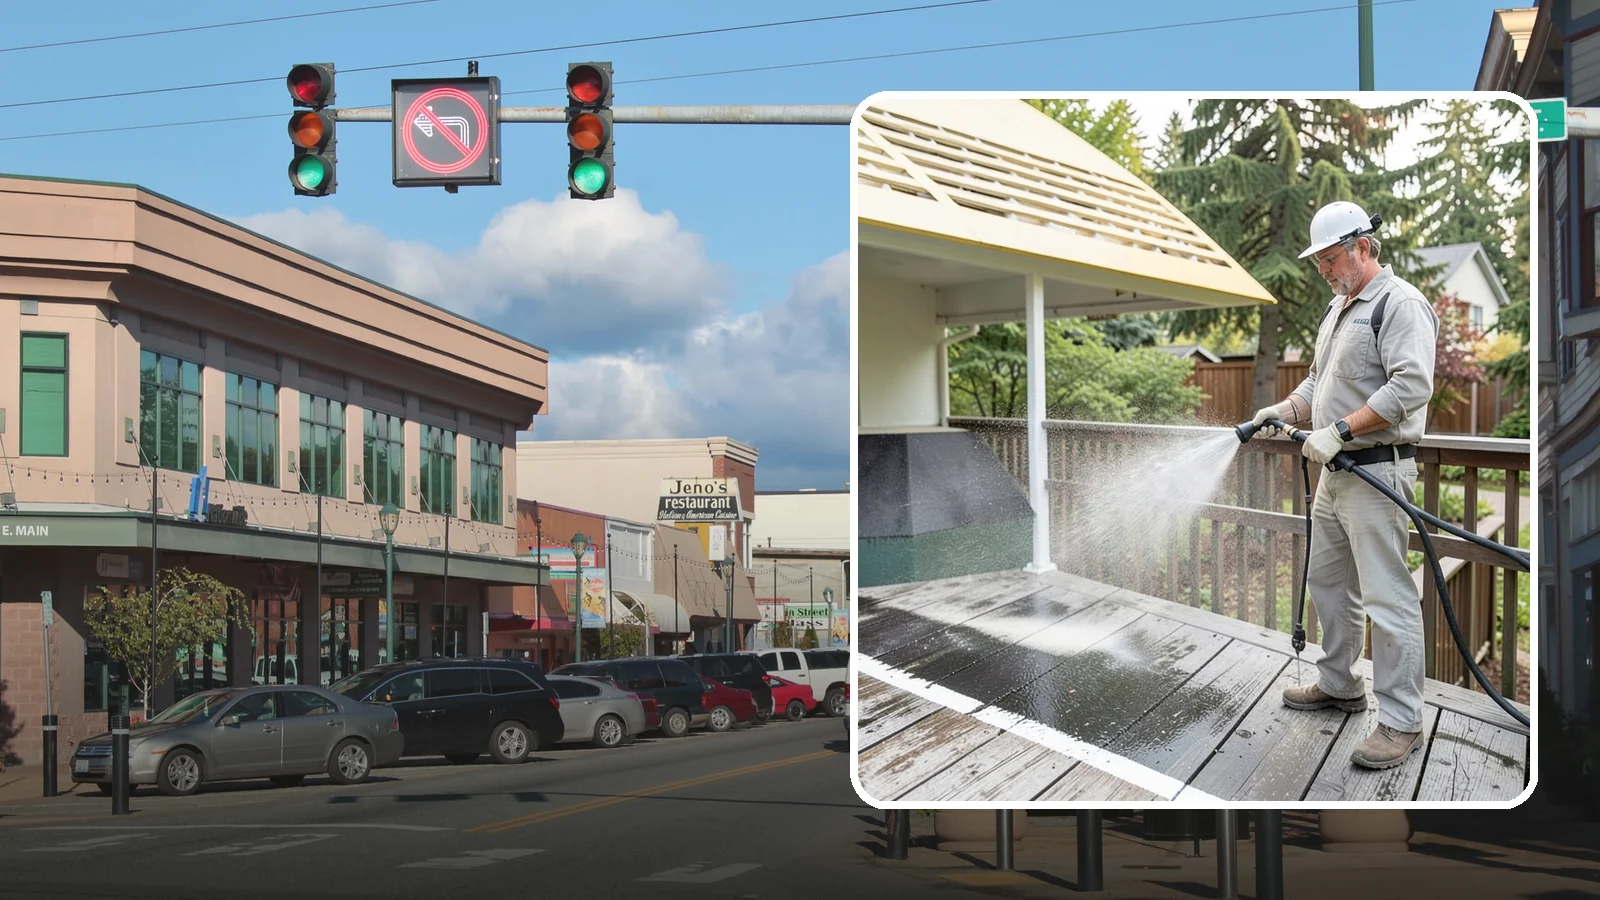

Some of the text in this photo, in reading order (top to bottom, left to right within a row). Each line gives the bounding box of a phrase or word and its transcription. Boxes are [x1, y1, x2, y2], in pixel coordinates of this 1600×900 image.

[670, 480, 728, 494] Jeno's
[665, 497, 731, 509] restaurant
[659, 510, 681, 520] Italian
[686, 510, 714, 519] American
[715, 510, 737, 519] Cuisine
[2, 525, 49, 536] E. MAIN
[786, 608, 795, 616] in
[798, 607, 828, 616] Street
[791, 619, 823, 627] lass
